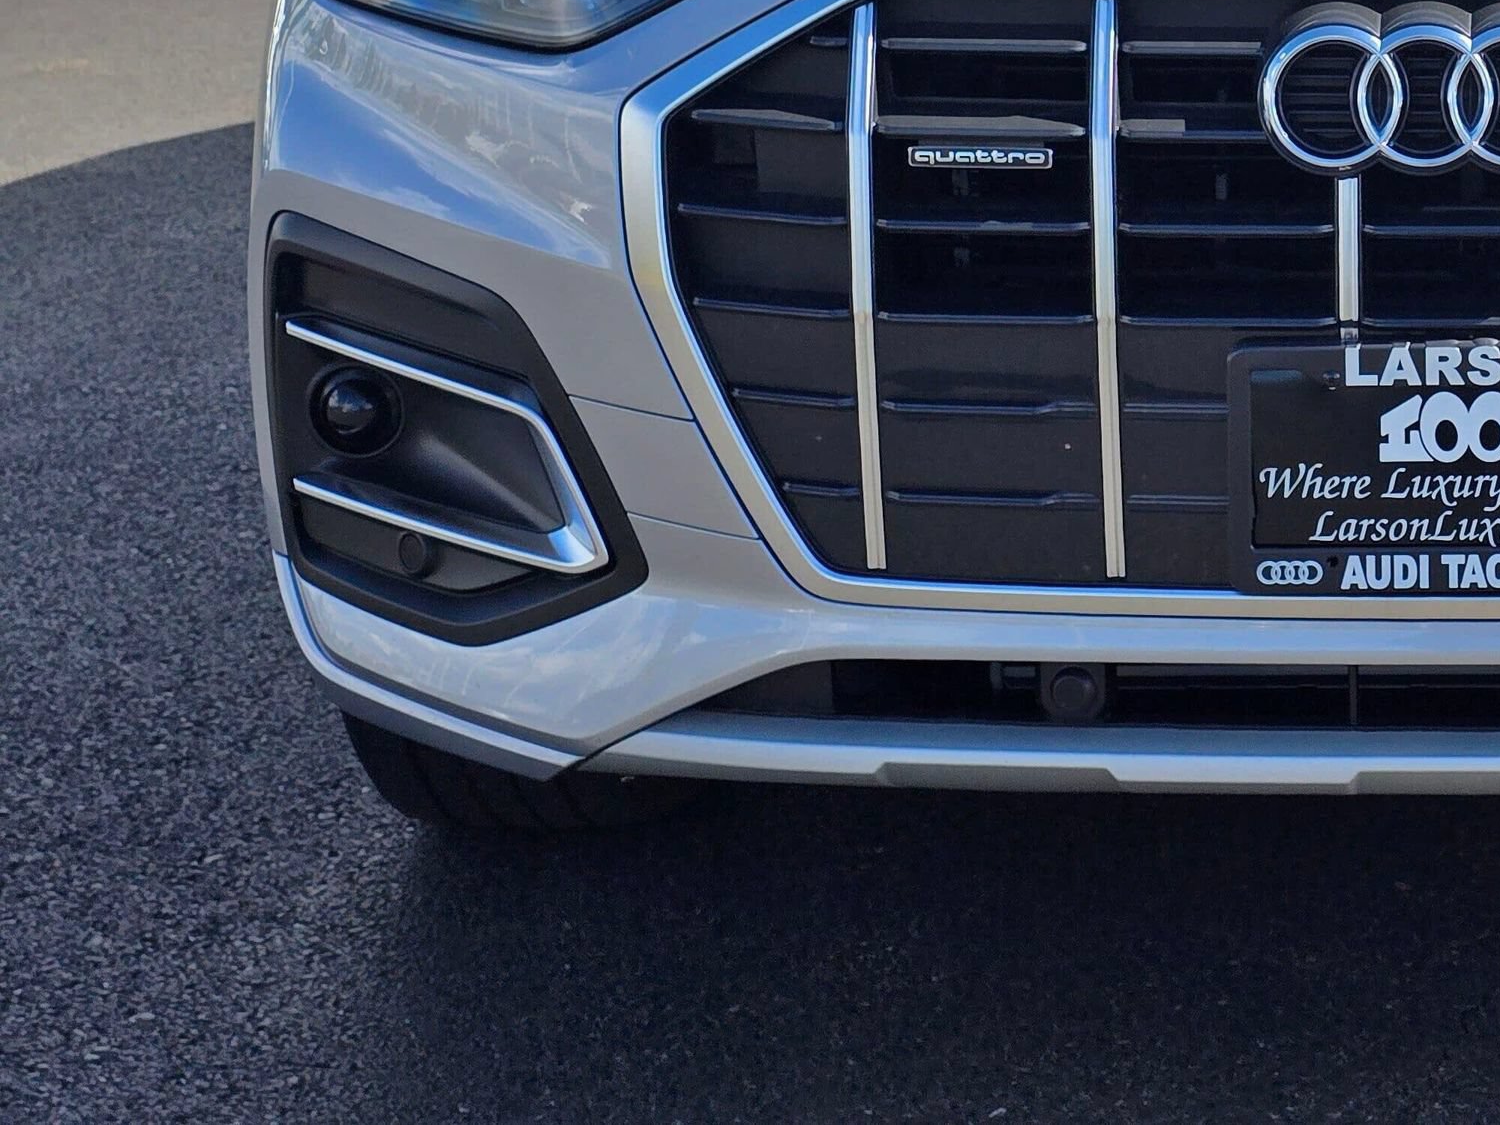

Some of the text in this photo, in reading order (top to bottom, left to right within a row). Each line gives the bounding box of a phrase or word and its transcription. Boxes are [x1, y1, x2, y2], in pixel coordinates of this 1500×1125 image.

[914, 149, 1046, 165] quattro
[1258, 463, 1371, 500] Where
[1340, 555, 1431, 590] AUDI
